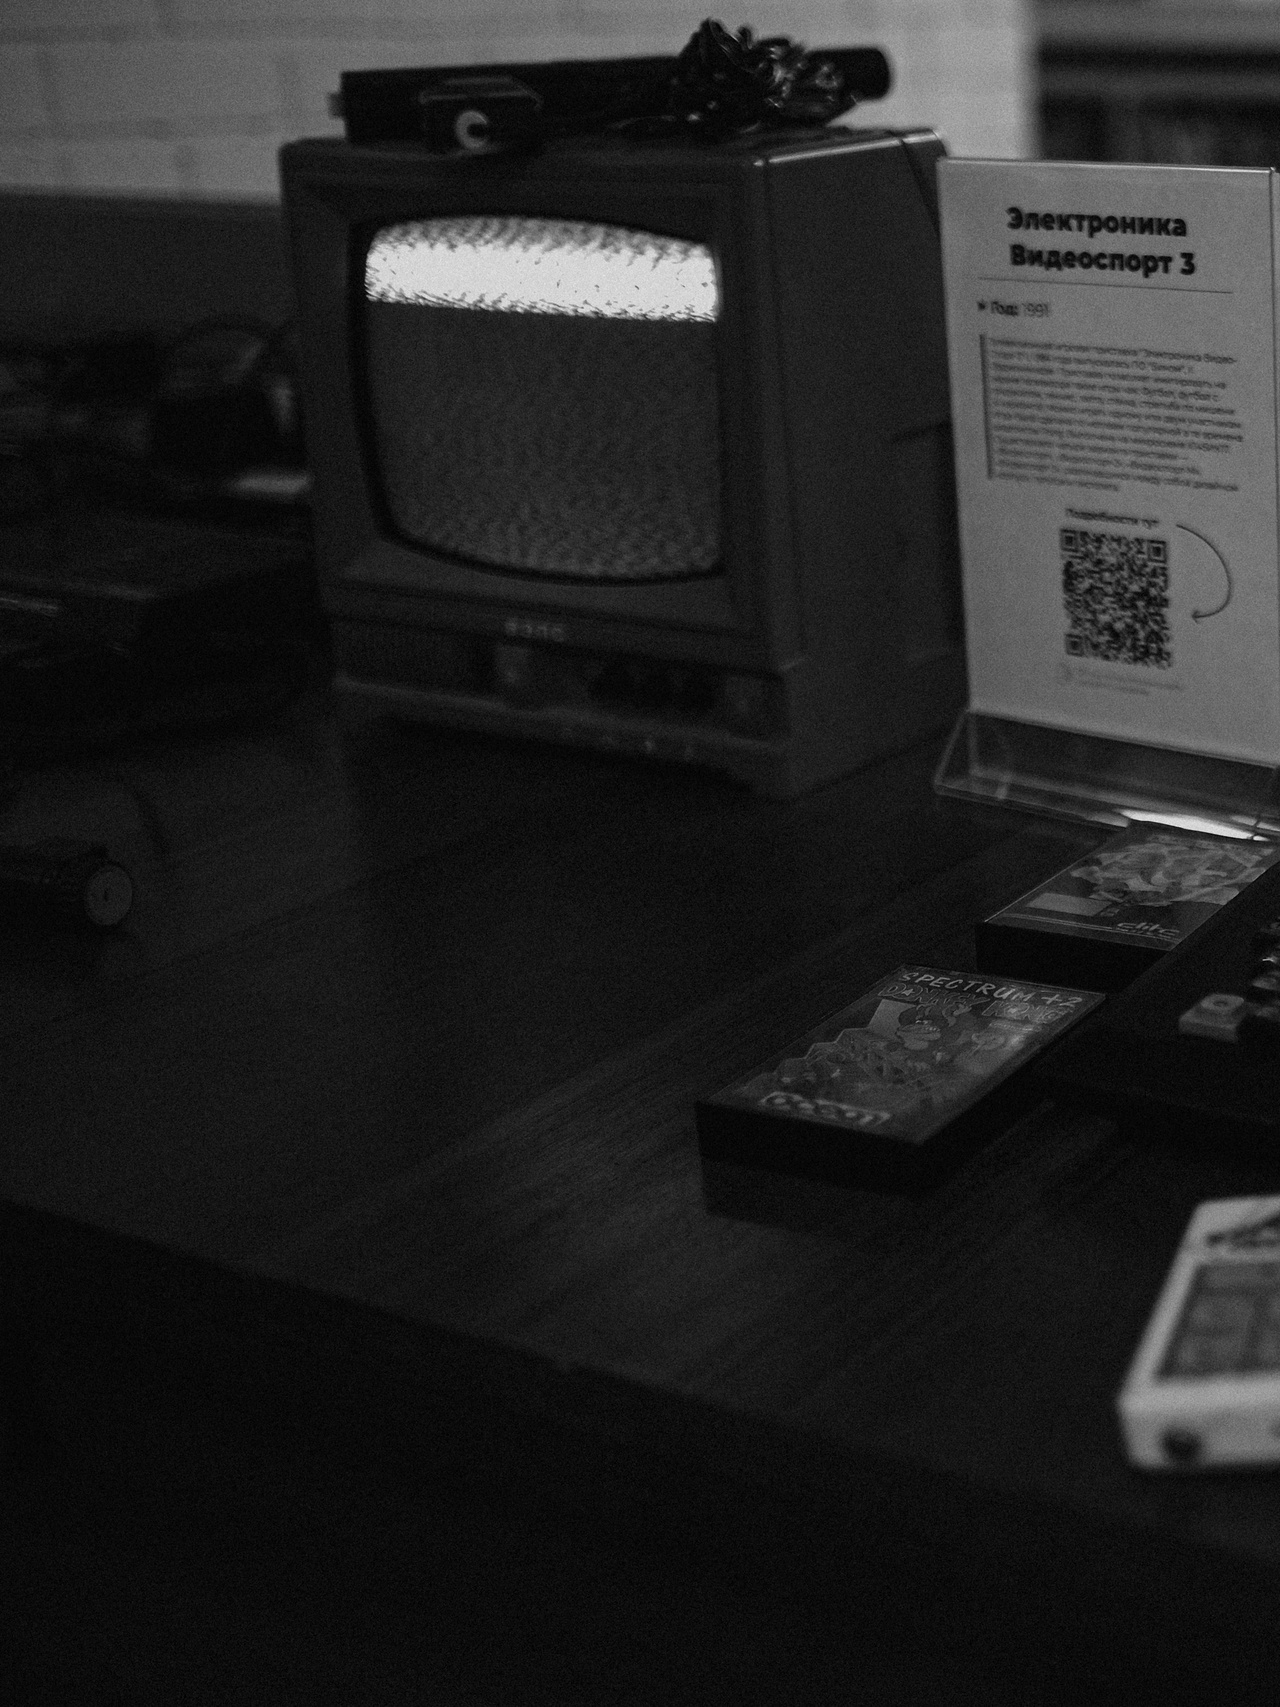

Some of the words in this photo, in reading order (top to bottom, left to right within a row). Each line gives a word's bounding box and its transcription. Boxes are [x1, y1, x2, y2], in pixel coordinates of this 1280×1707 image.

[1006, 207, 1187, 237] Электроника
[1010, 244, 1172, 277] Видеоспорт
[1180, 252, 1195, 275] 3
[899, 971, 1036, 1001] SPECTRUM
[1041, 989, 1084, 1008] +2
